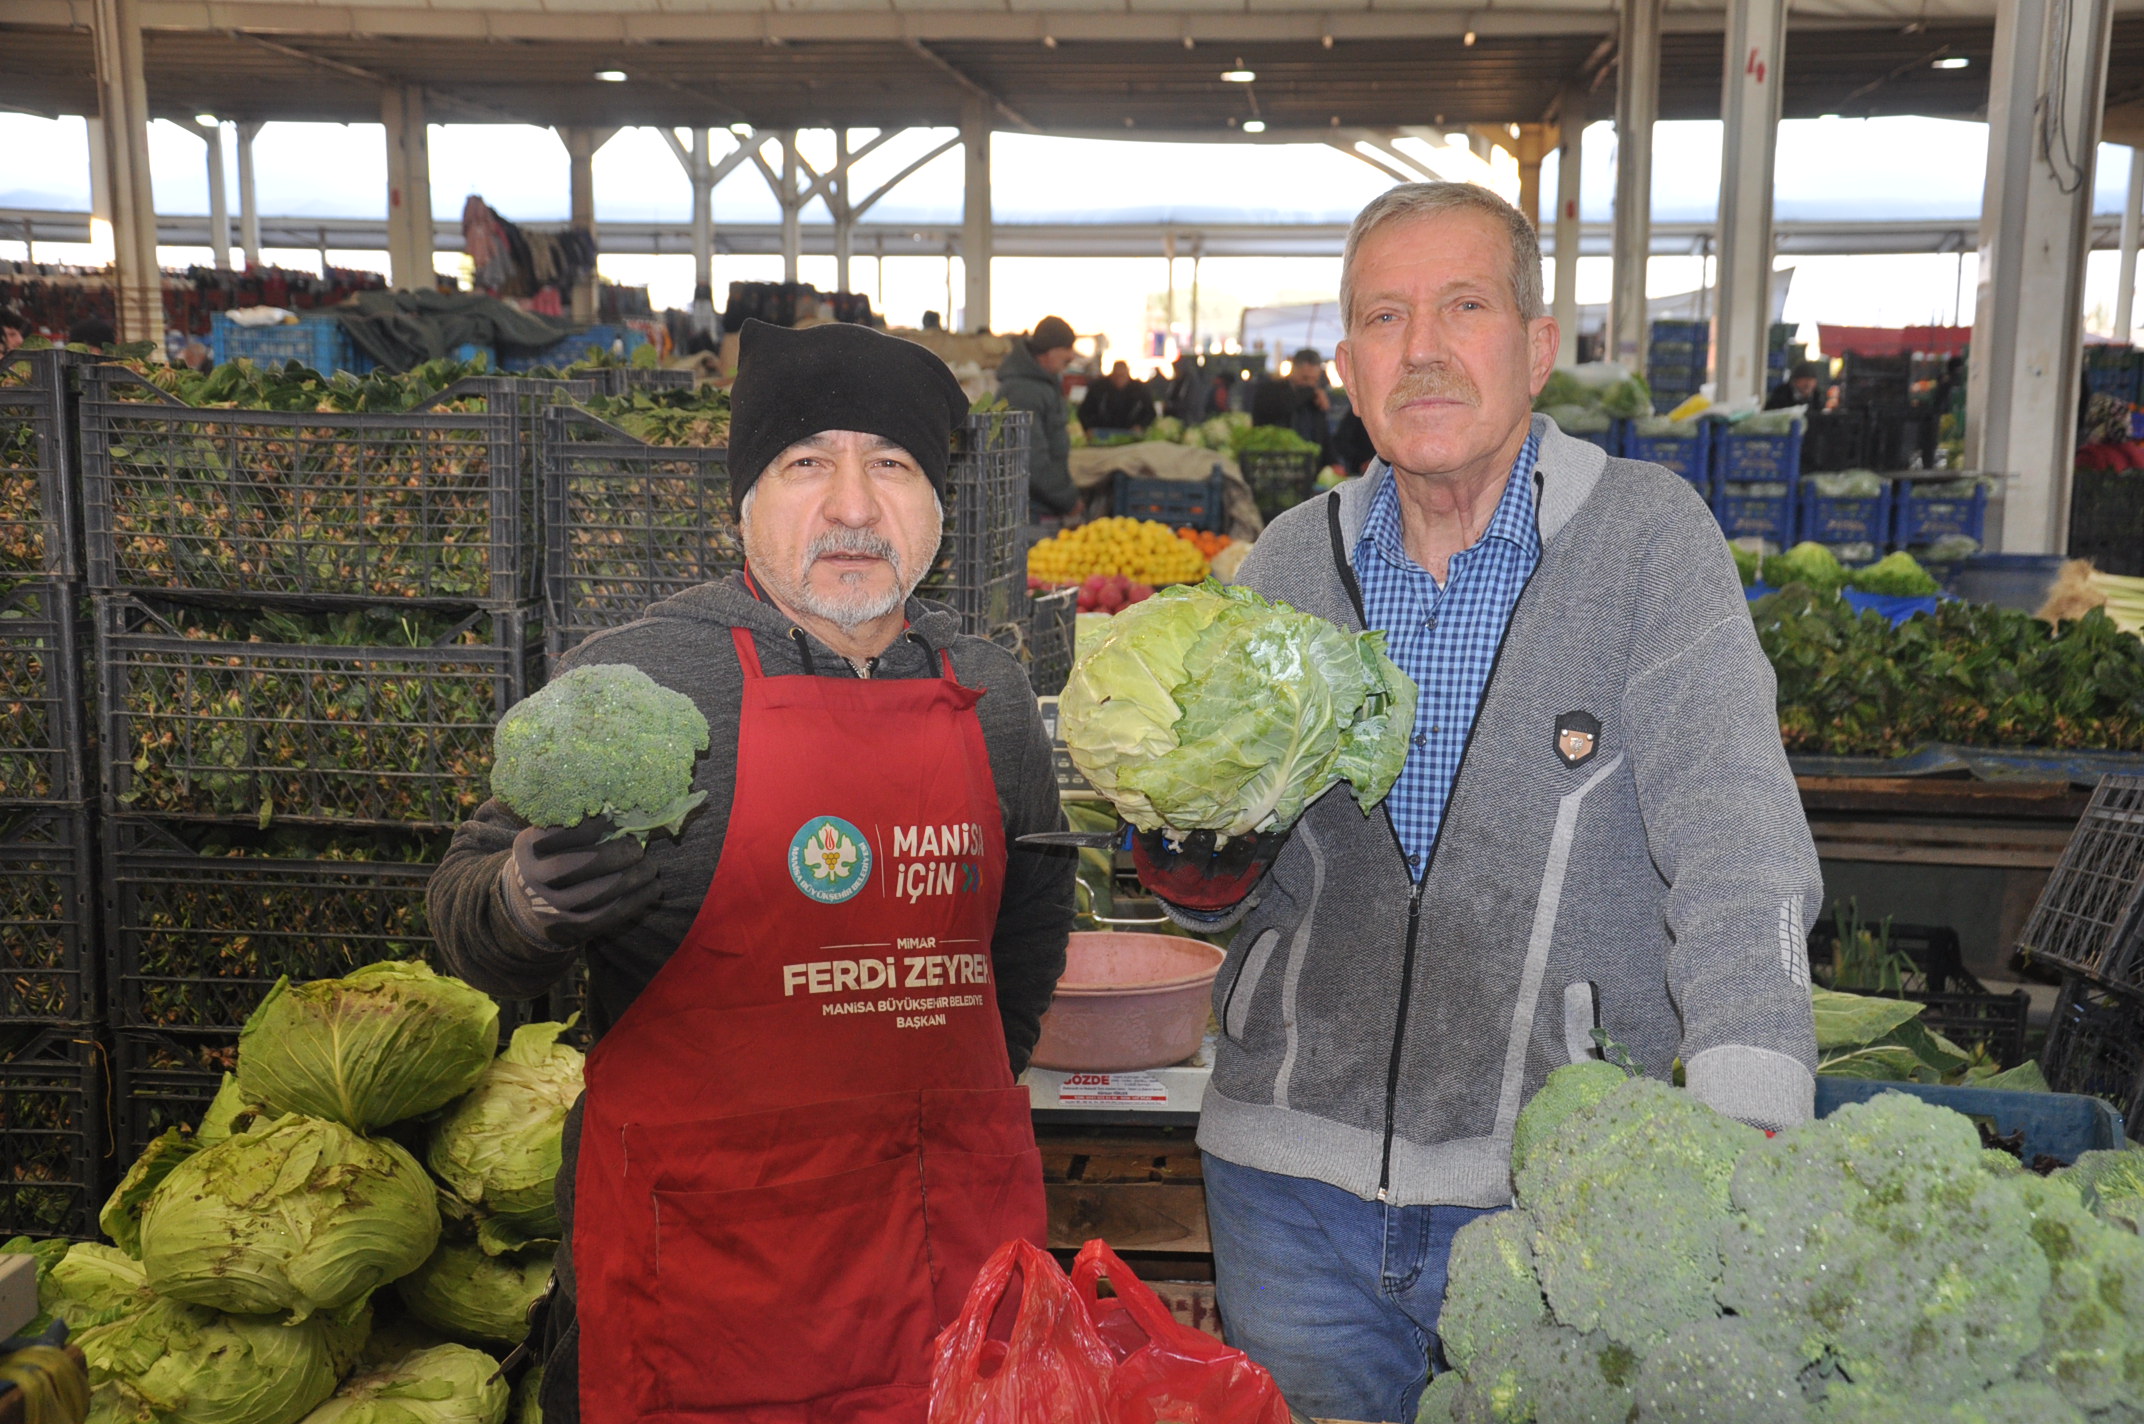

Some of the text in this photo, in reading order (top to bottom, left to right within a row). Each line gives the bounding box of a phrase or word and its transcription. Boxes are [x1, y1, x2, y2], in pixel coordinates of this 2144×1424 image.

[896, 861, 957, 905] İÇİN
[897, 937, 936, 950] MİMAR
[783, 956, 897, 997] FERDİ
[822, 1001, 876, 1016] MANİSA
[877, 996, 949, 1012] BÜYÜKŞEHİR
[896, 1014, 947, 1029] BAŞKANI
